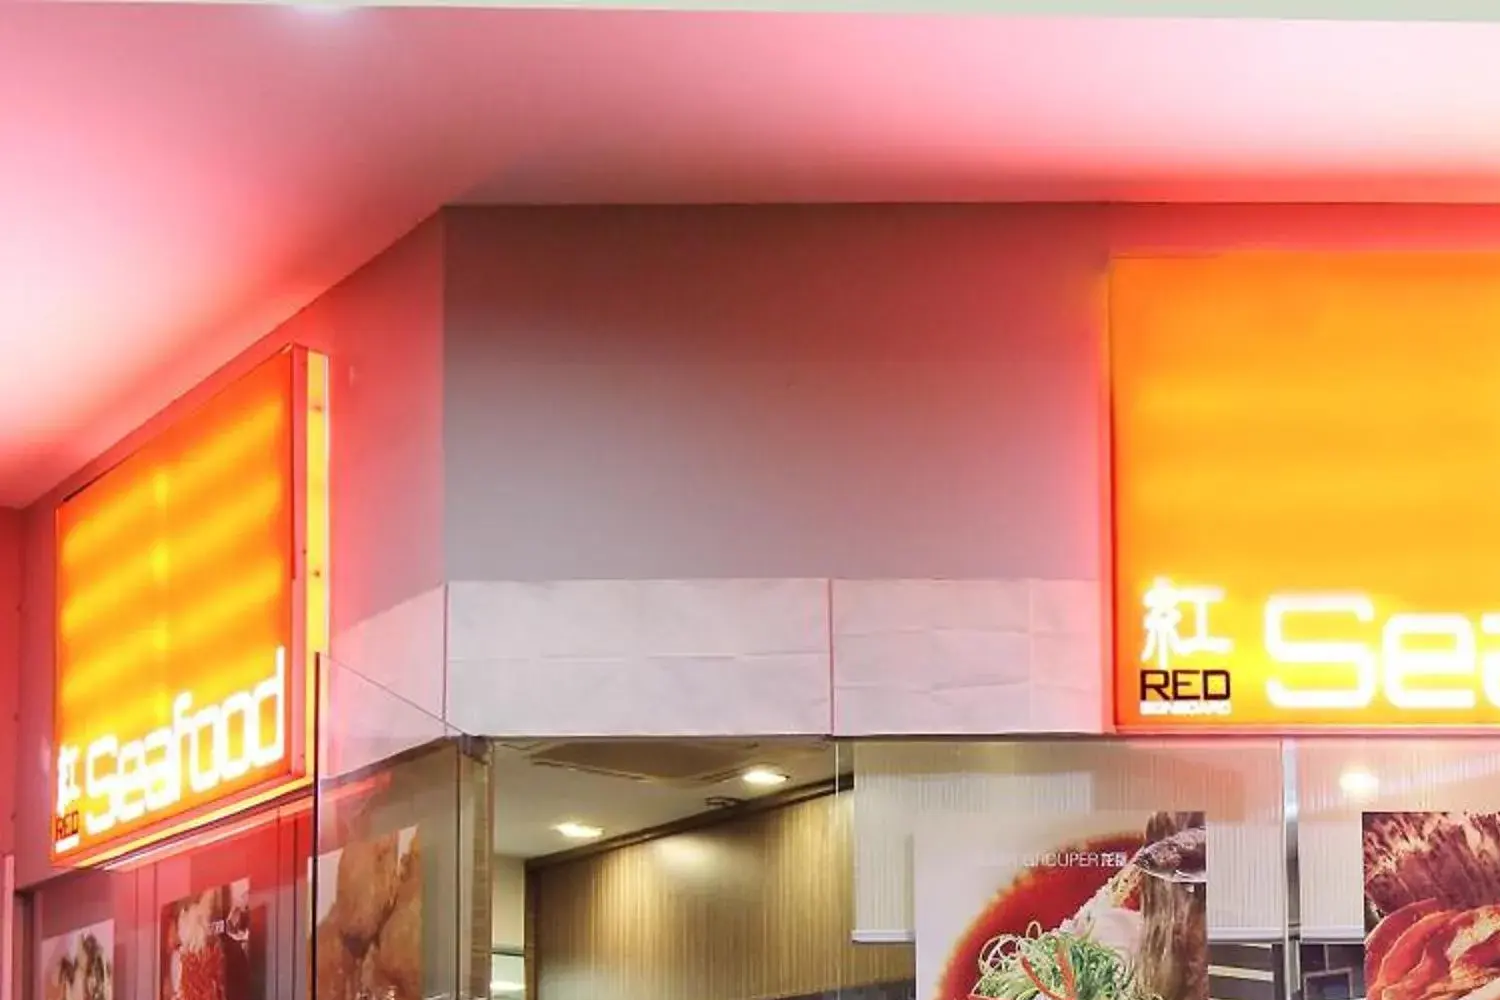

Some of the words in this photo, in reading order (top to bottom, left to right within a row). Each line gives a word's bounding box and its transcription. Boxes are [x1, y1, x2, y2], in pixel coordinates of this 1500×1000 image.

[1140, 669, 1231, 701] RED
[84, 645, 286, 837] Seafood
[55, 809, 80, 840] RED
